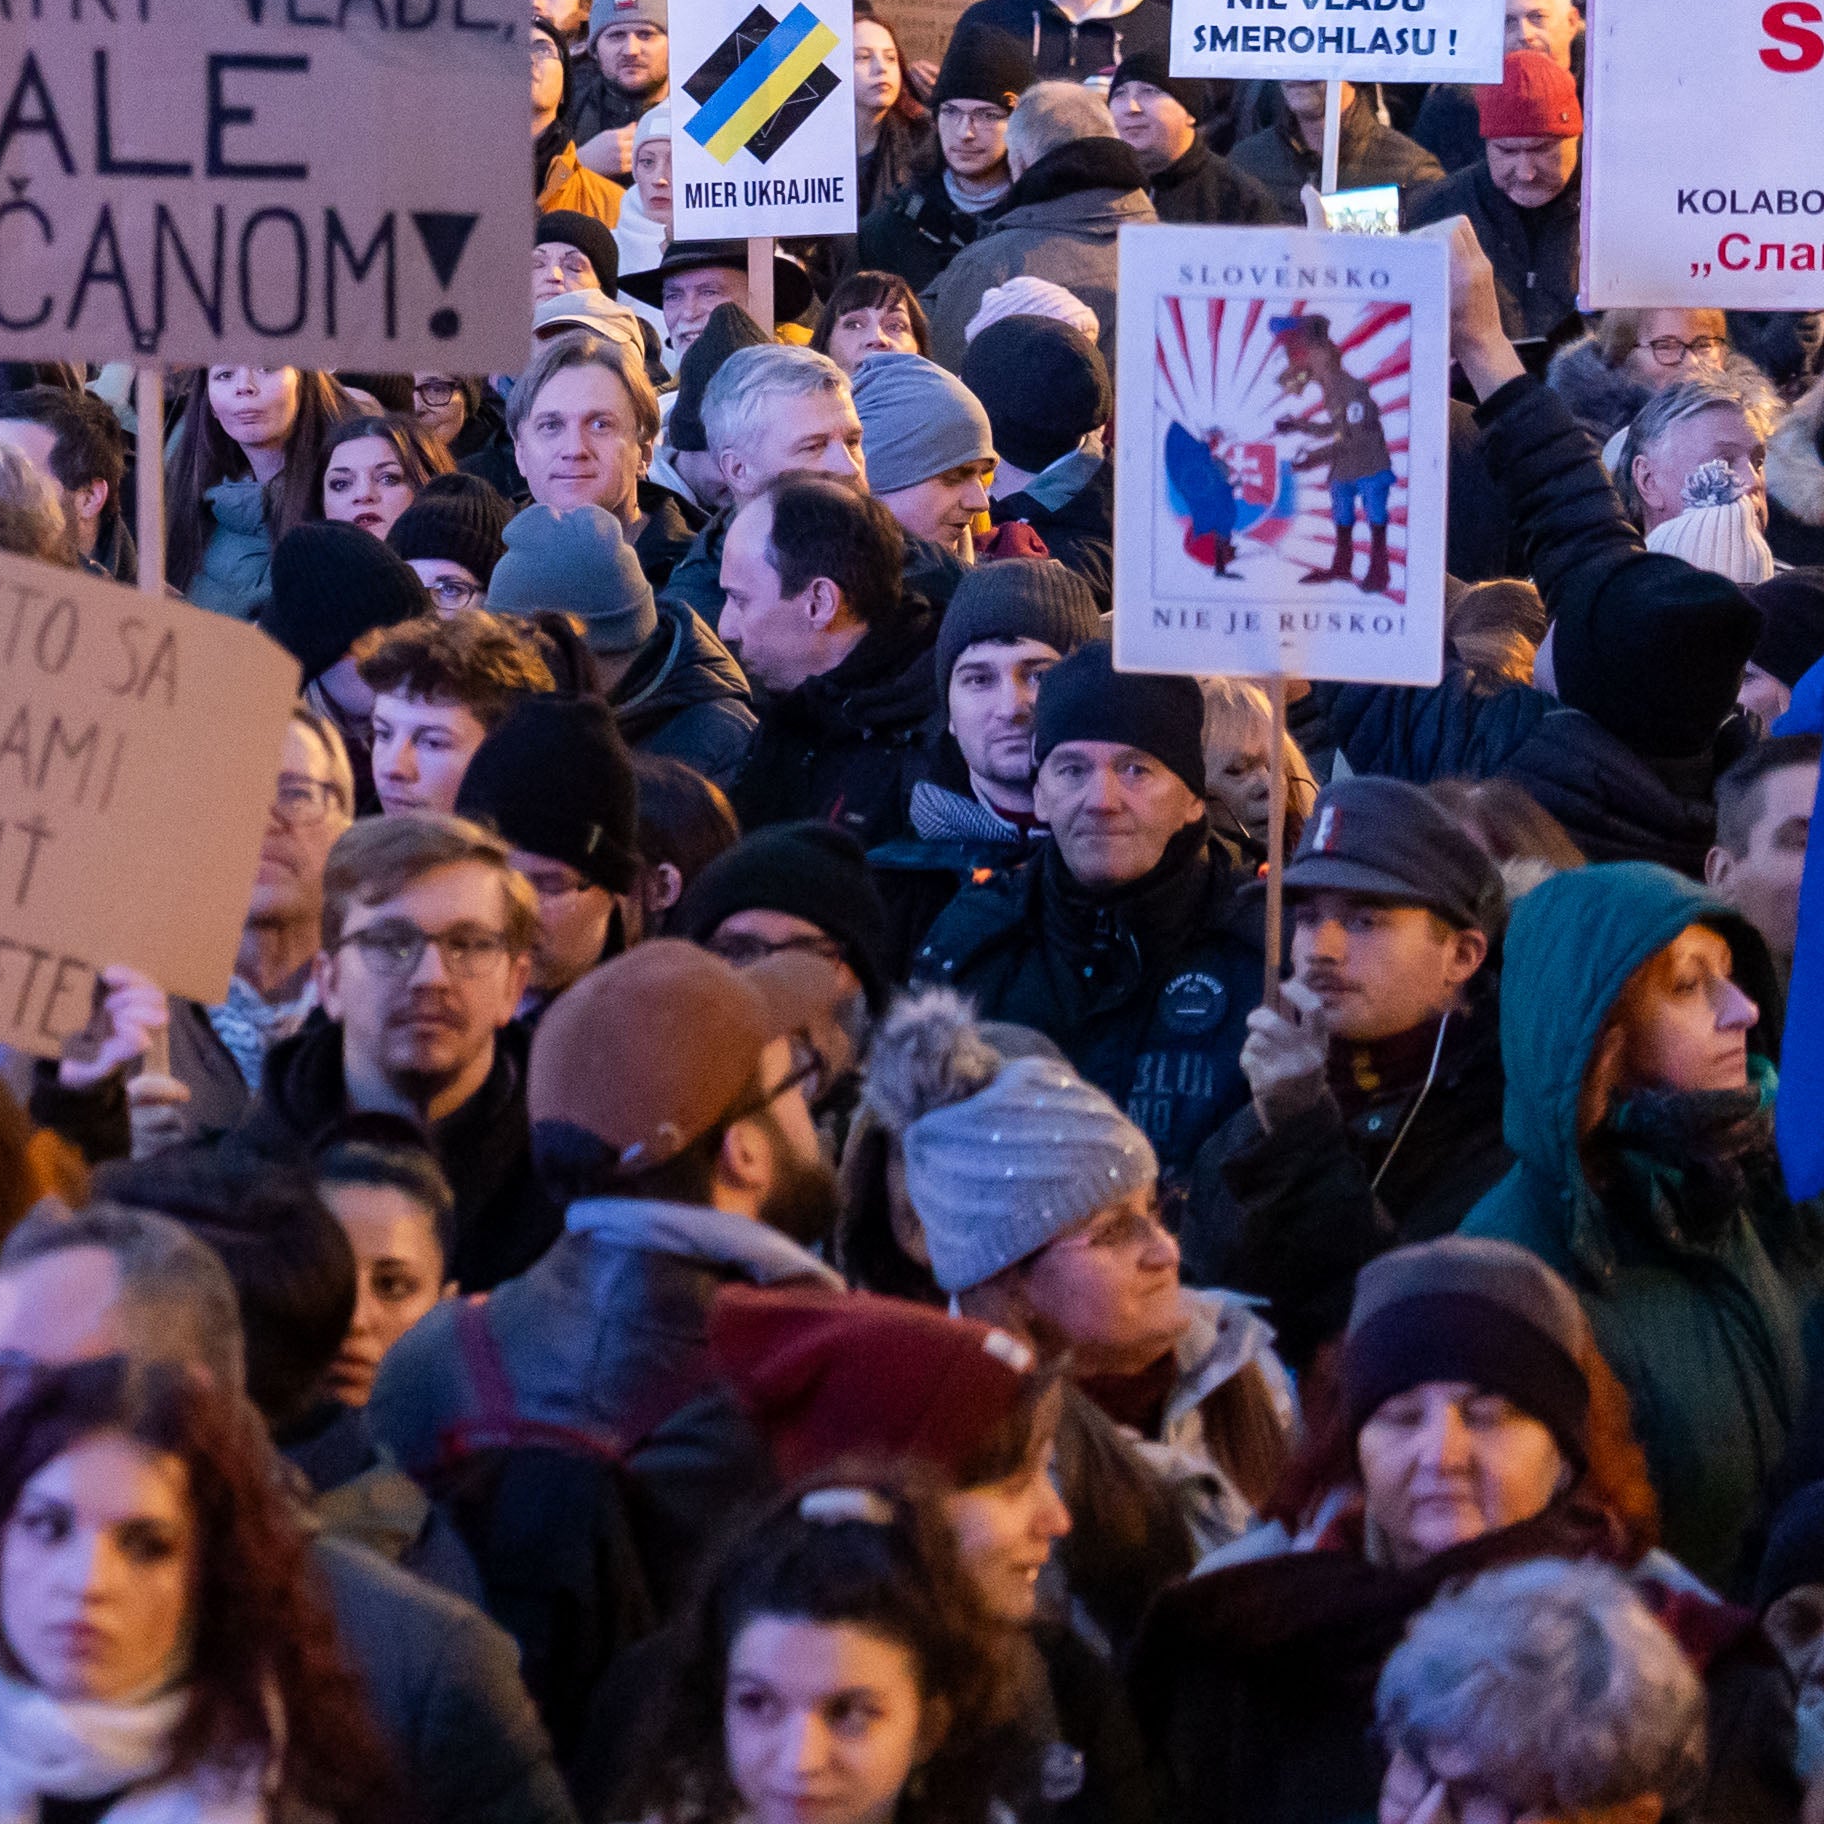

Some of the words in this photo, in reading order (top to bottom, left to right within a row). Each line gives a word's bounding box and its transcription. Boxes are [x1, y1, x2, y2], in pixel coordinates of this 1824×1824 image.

[1193, 24, 1438, 57] SMEROHLASU
[685, 180, 738, 210] MIER
[744, 176, 845, 208] UKRAJINE
[1690, 231, 1824, 279] „Сла
[1179, 263, 1392, 290] SLOVENSKO
[1153, 606, 1211, 630] NIE
[1225, 608, 1262, 634] JE
[1279, 608, 1407, 637] RUSKO!
[106, 617, 179, 710] SA
